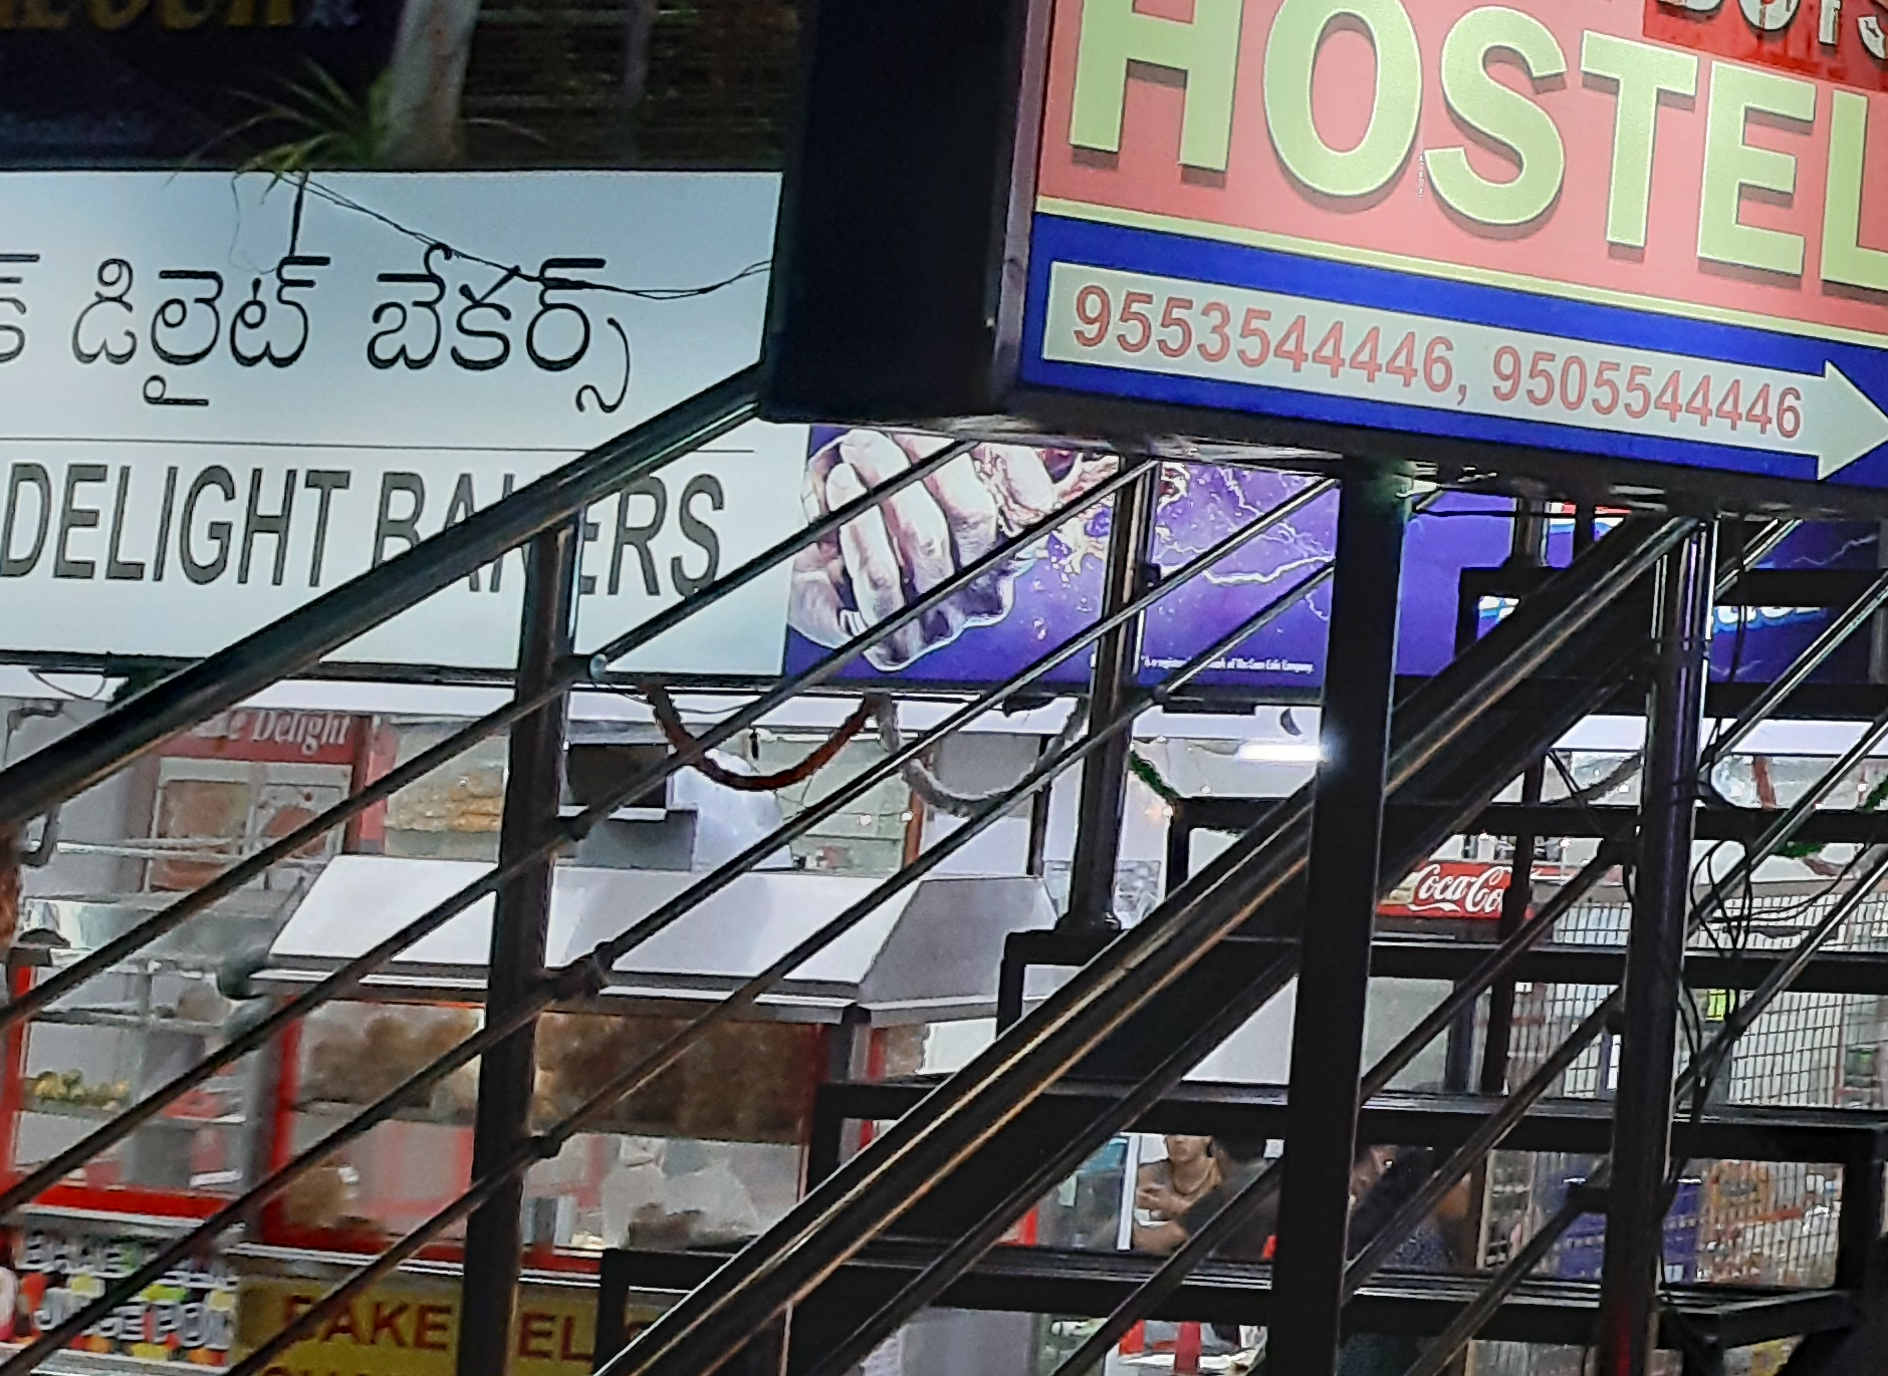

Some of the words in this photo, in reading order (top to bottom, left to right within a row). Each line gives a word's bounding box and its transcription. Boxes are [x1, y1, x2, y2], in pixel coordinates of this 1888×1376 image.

[1073, 283, 1469, 407] 9553544446,
[1491, 345, 1803, 440] 9505544446
[0, 462, 351, 588] DELIGHT
[252, 710, 350, 755] Delight
